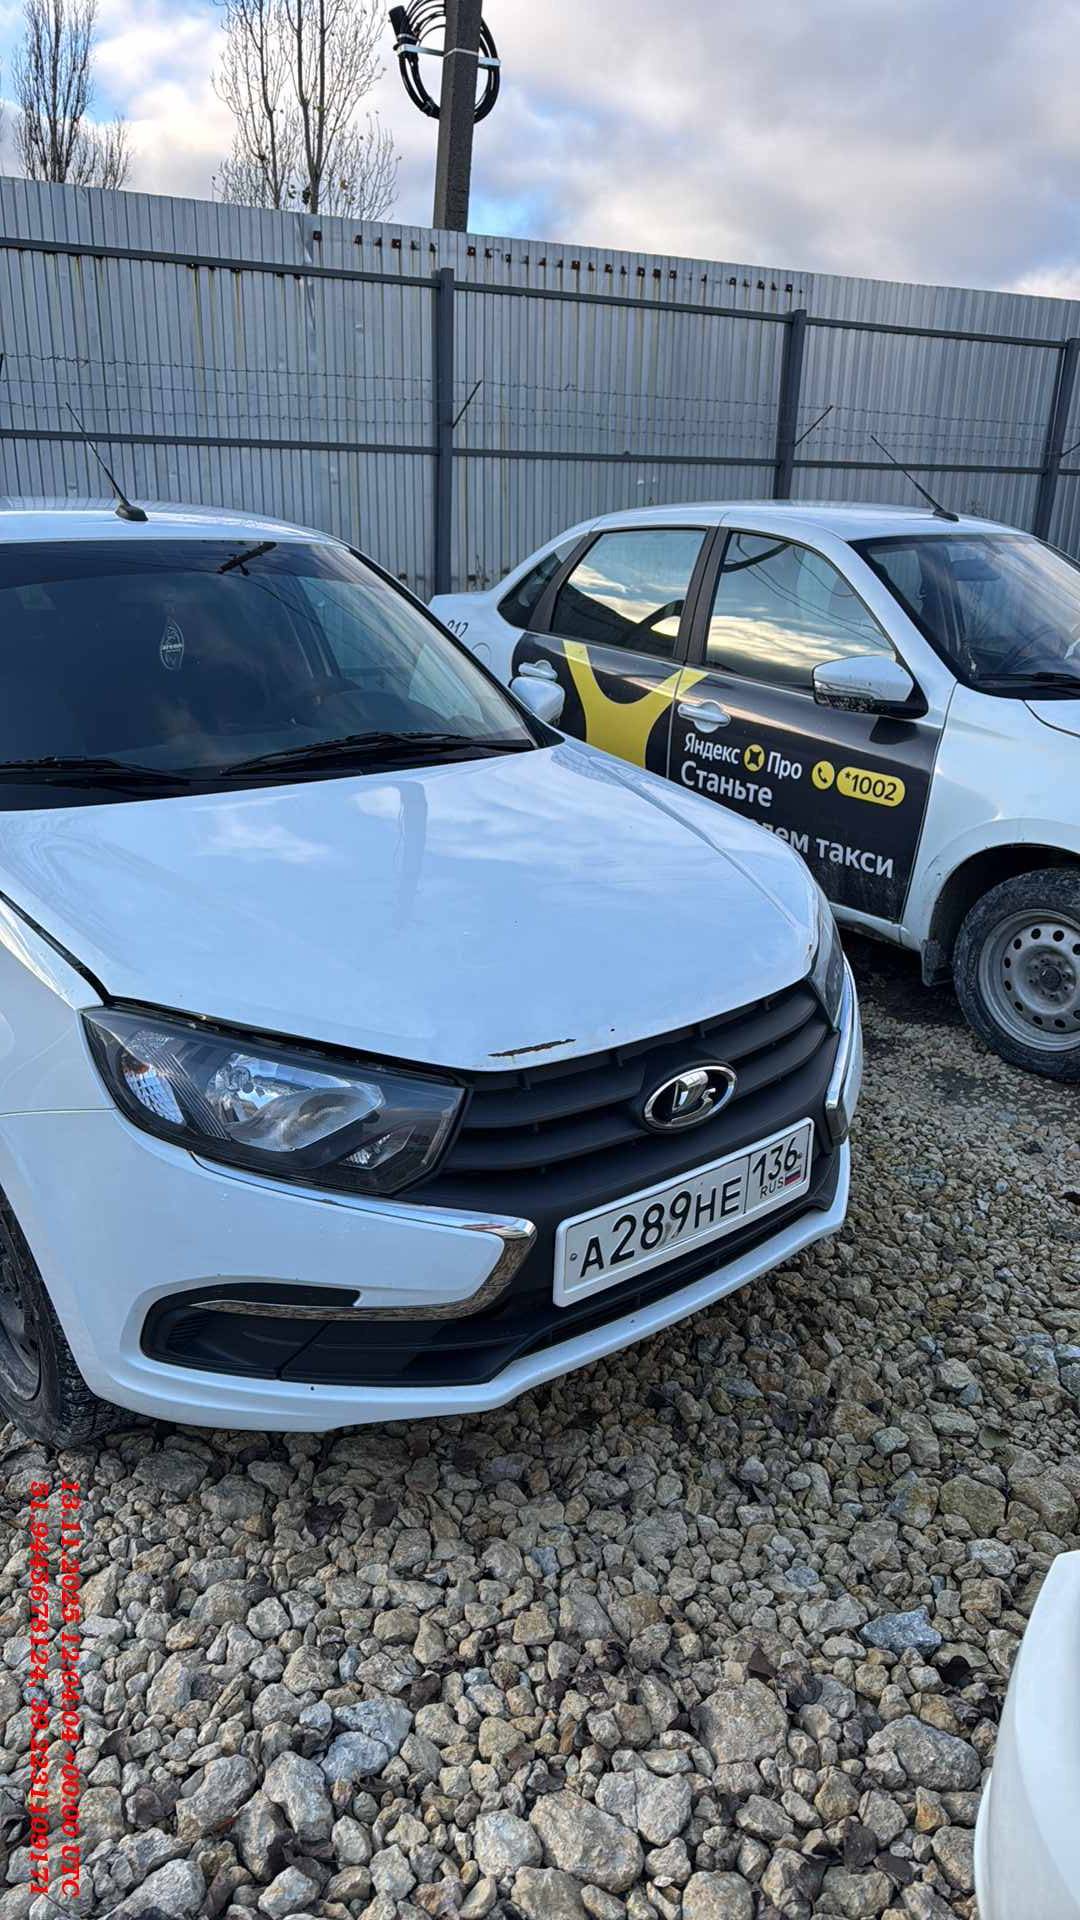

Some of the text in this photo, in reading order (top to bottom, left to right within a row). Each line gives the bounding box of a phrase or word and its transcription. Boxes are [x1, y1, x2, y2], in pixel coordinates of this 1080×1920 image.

[683, 732, 802, 780] Яндекс Про
[680, 760, 773, 807] Станьте
[815, 837, 895, 879] такси
[580, 1137, 798, 1278] А289НЕ 136
[760, 1176, 785, 1199] RUS
